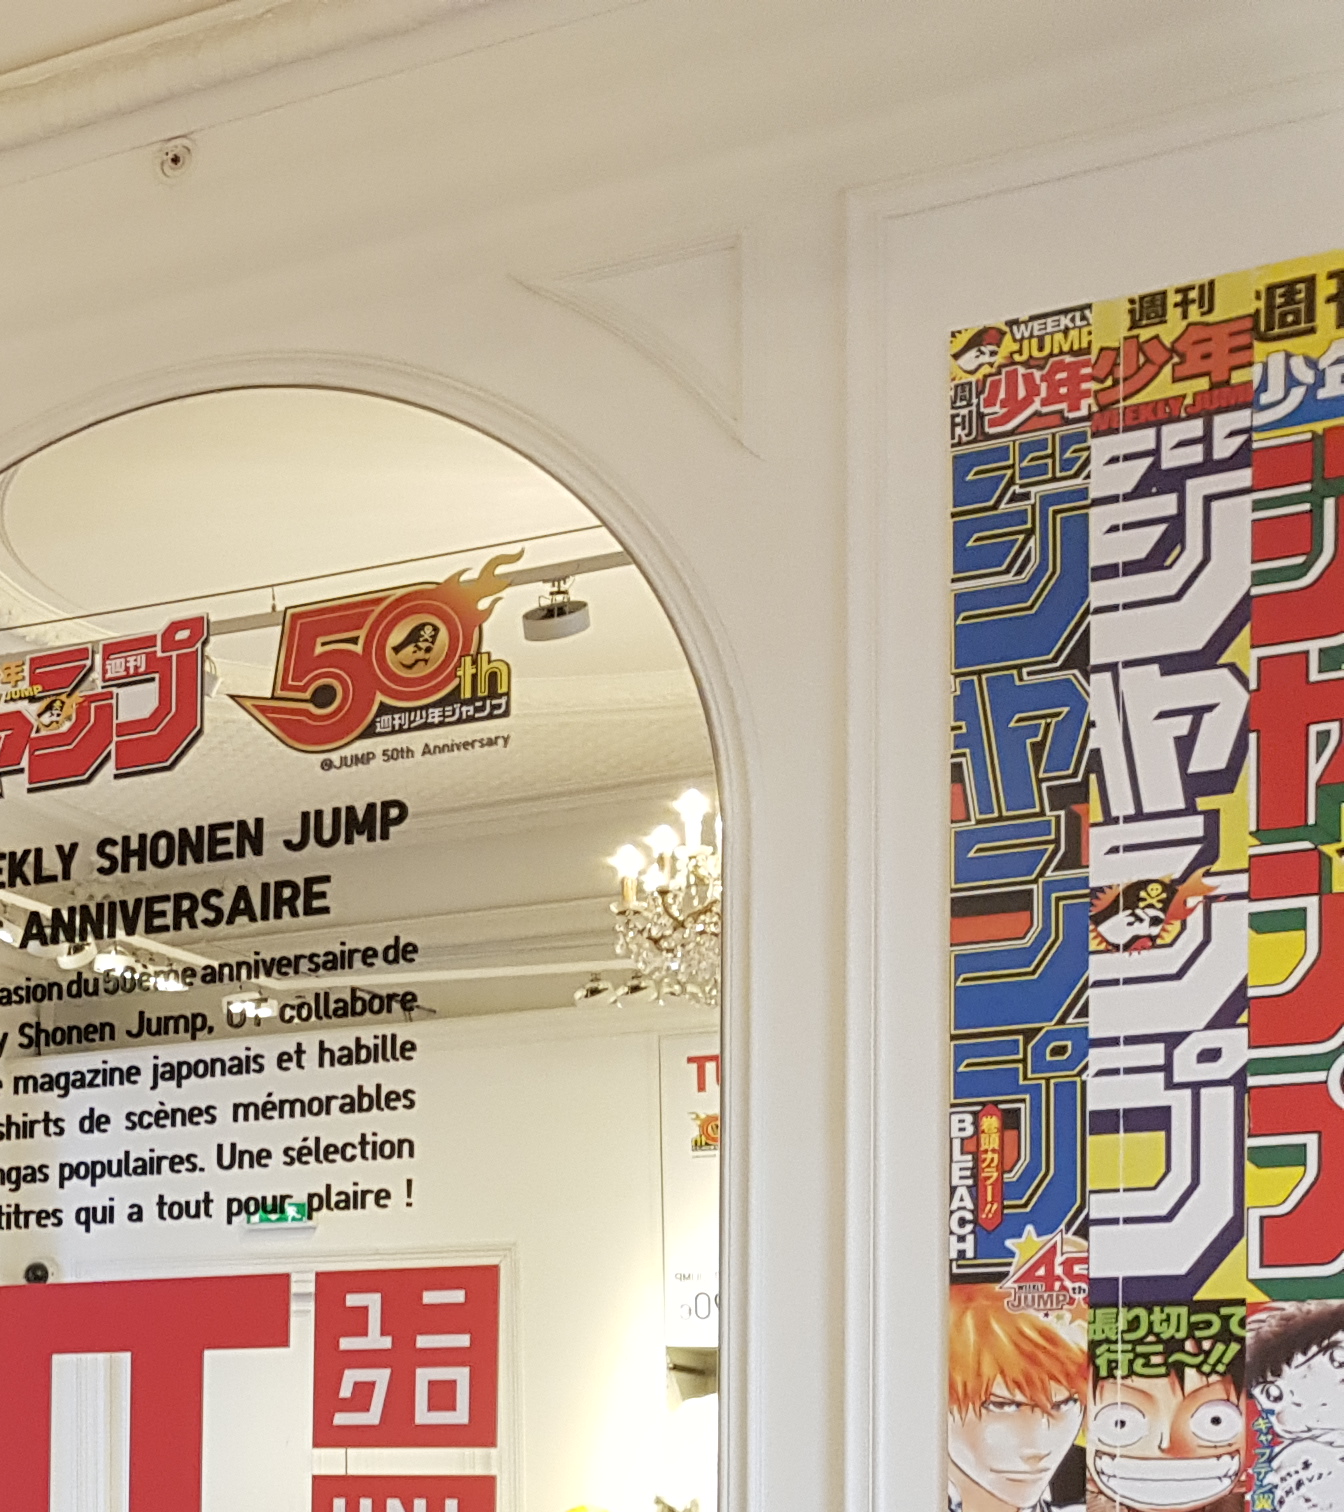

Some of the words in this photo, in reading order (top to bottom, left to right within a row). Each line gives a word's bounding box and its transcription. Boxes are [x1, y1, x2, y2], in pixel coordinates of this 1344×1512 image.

[1127, 279, 1216, 331] 週刊
[983, 355, 1092, 433] 少年
[1092, 313, 1253, 409] 少年
[105, 653, 147, 677] 週刊
[382, 746, 415, 763] 50th
[421, 733, 512, 757] Anniversary
[96, 817, 265, 876] SHONEN
[283, 799, 409, 852] JUMP
[19, 874, 332, 949] ANNIVERSAIRE
[66, 970, 101, 1001] du
[200, 942, 378, 986] anniversaire
[382, 935, 420, 966] de
[17, 1007, 116, 1051] Shonen
[125, 1008, 215, 1042] Jump,
[278, 983, 418, 1024] collabore
[12, 1058, 142, 1099] magazine
[150, 1047, 265, 1091] japonais
[276, 1041, 308, 1071] et
[317, 1031, 417, 1069] habille
[78, 1106, 112, 1136] de
[124, 1098, 218, 1132] scènes
[231, 1082, 417, 1123] mémorables
[58, 1146, 206, 1189] populaires.
[215, 1141, 274, 1172] Une
[281, 1131, 416, 1170] sélection
[949, 1113, 975, 1260] BLEACH
[73, 1195, 116, 1234] qui
[126, 1201, 145, 1225] a
[155, 1190, 214, 1222] tout
[225, 1193, 294, 1227] pour
[305, 1182, 393, 1220] plaire
[404, 1177, 415, 1209] !
